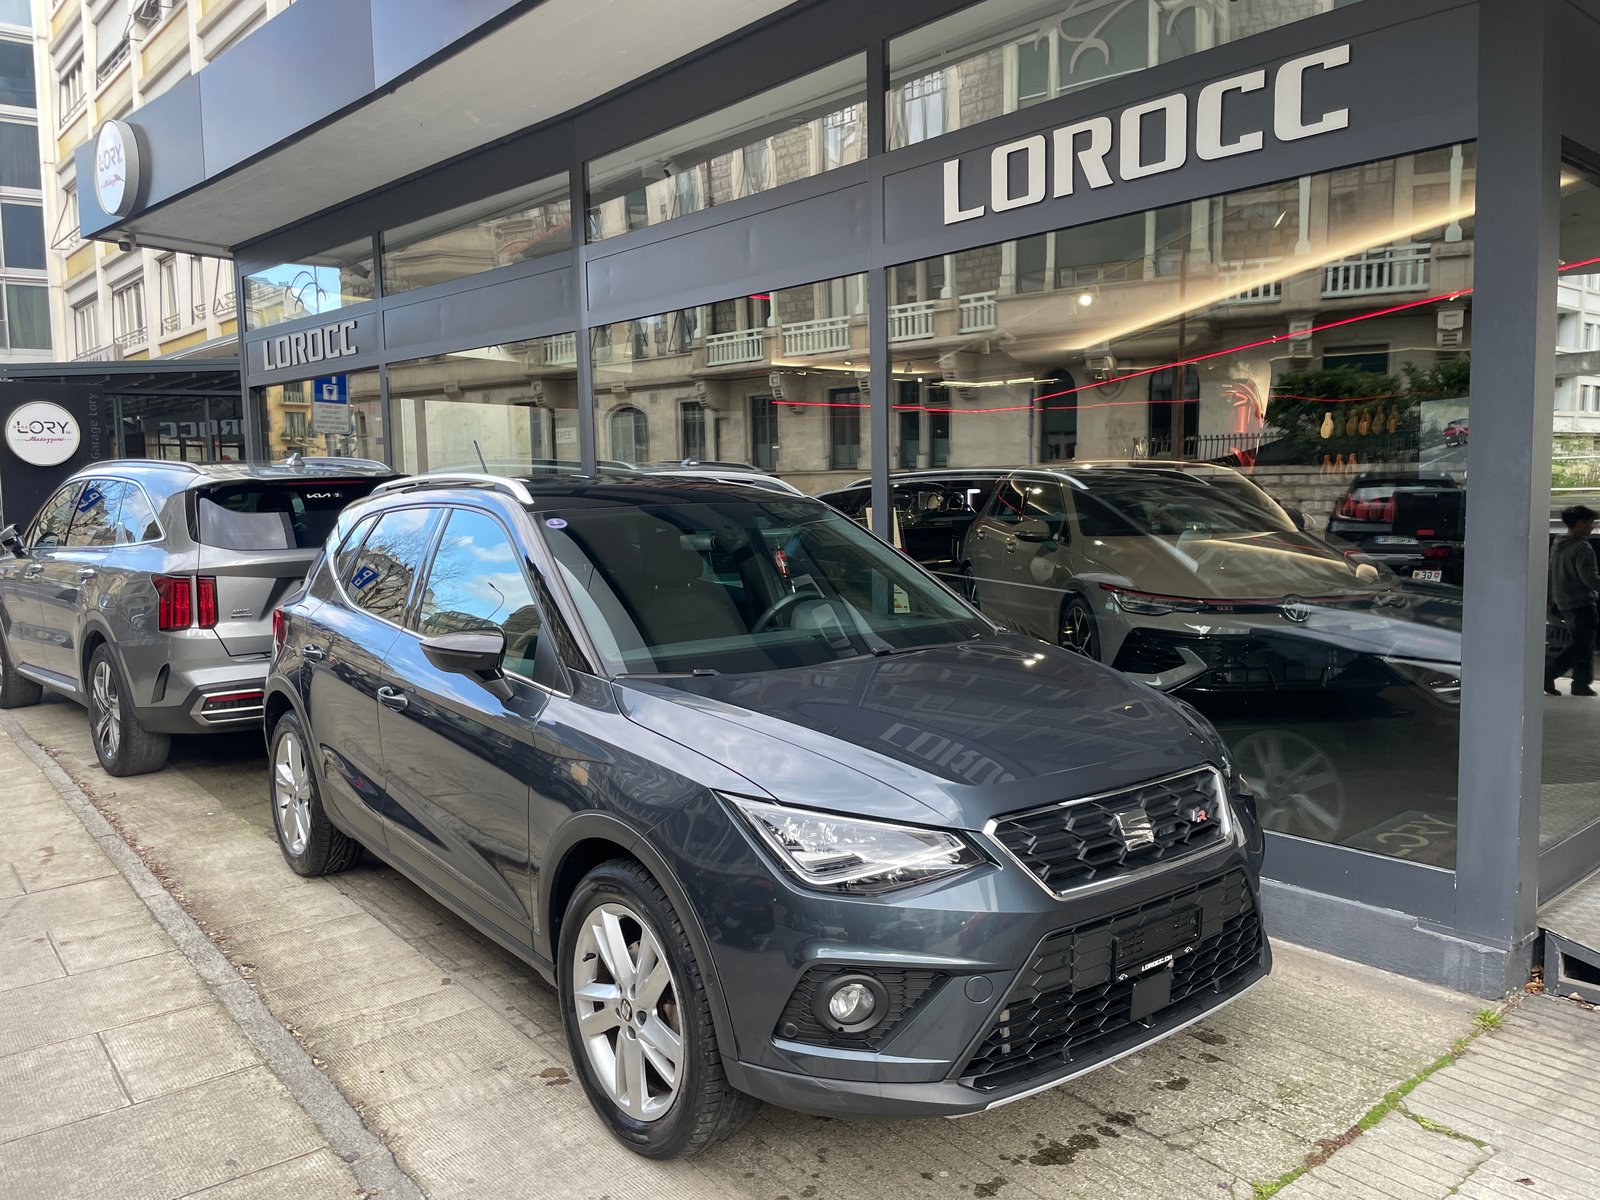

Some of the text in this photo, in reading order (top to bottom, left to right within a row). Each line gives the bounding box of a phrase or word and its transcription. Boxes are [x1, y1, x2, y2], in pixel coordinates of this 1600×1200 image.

[944, 44, 1350, 225] LOROCC
[263, 320, 357, 370] LOROCC
[16, 421, 69, 434] LORY
[88, 394, 100, 459] Garage Lory
